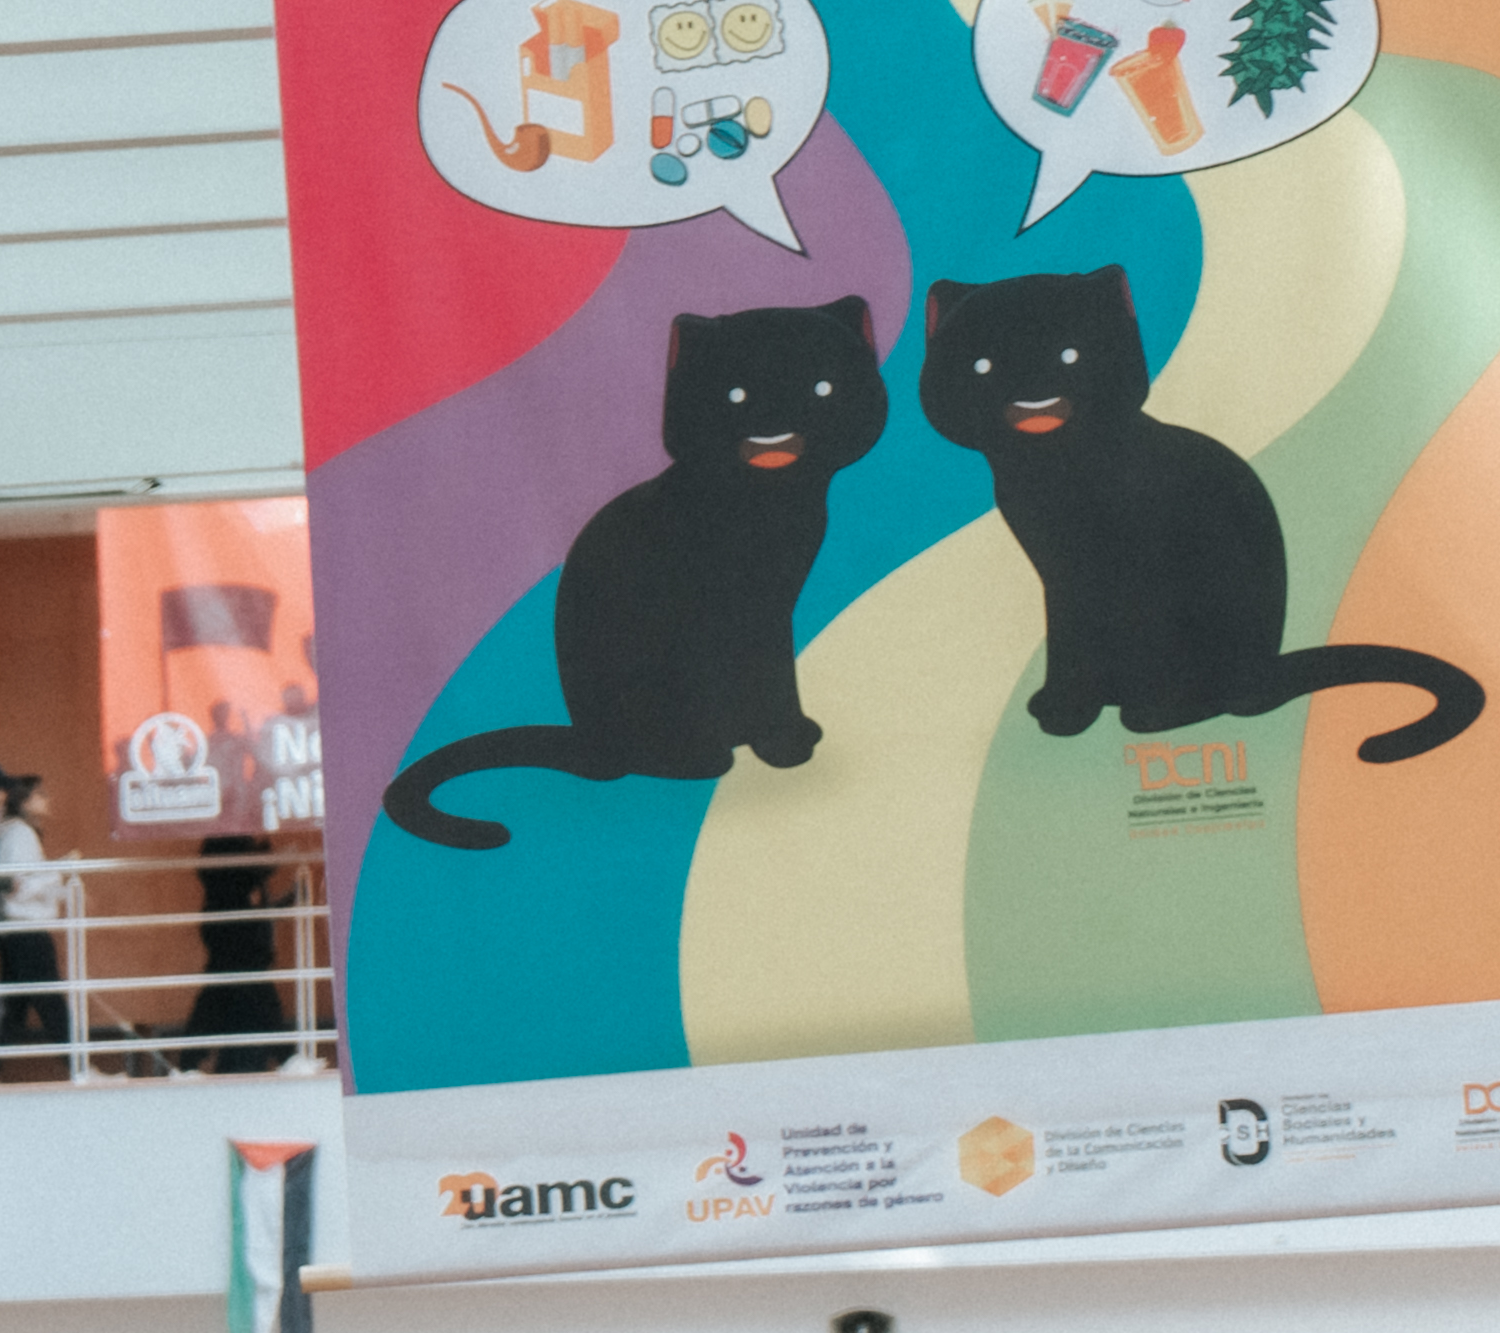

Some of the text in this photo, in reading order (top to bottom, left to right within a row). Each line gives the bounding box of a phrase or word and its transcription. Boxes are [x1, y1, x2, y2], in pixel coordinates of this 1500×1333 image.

[1281, 1101, 1351, 1116] Ciencias
[780, 1123, 868, 1140] Unidad de
[1282, 1117, 1351, 1132] Sociales
[1283, 1127, 1396, 1146] Humanidades
[782, 1140, 894, 1159] Prevención y
[783, 1158, 896, 1177] Atención a la
[782, 1176, 897, 1194] Violencia por
[686, 1193, 776, 1223] UPAV
[785, 1192, 944, 1213] razones de género
